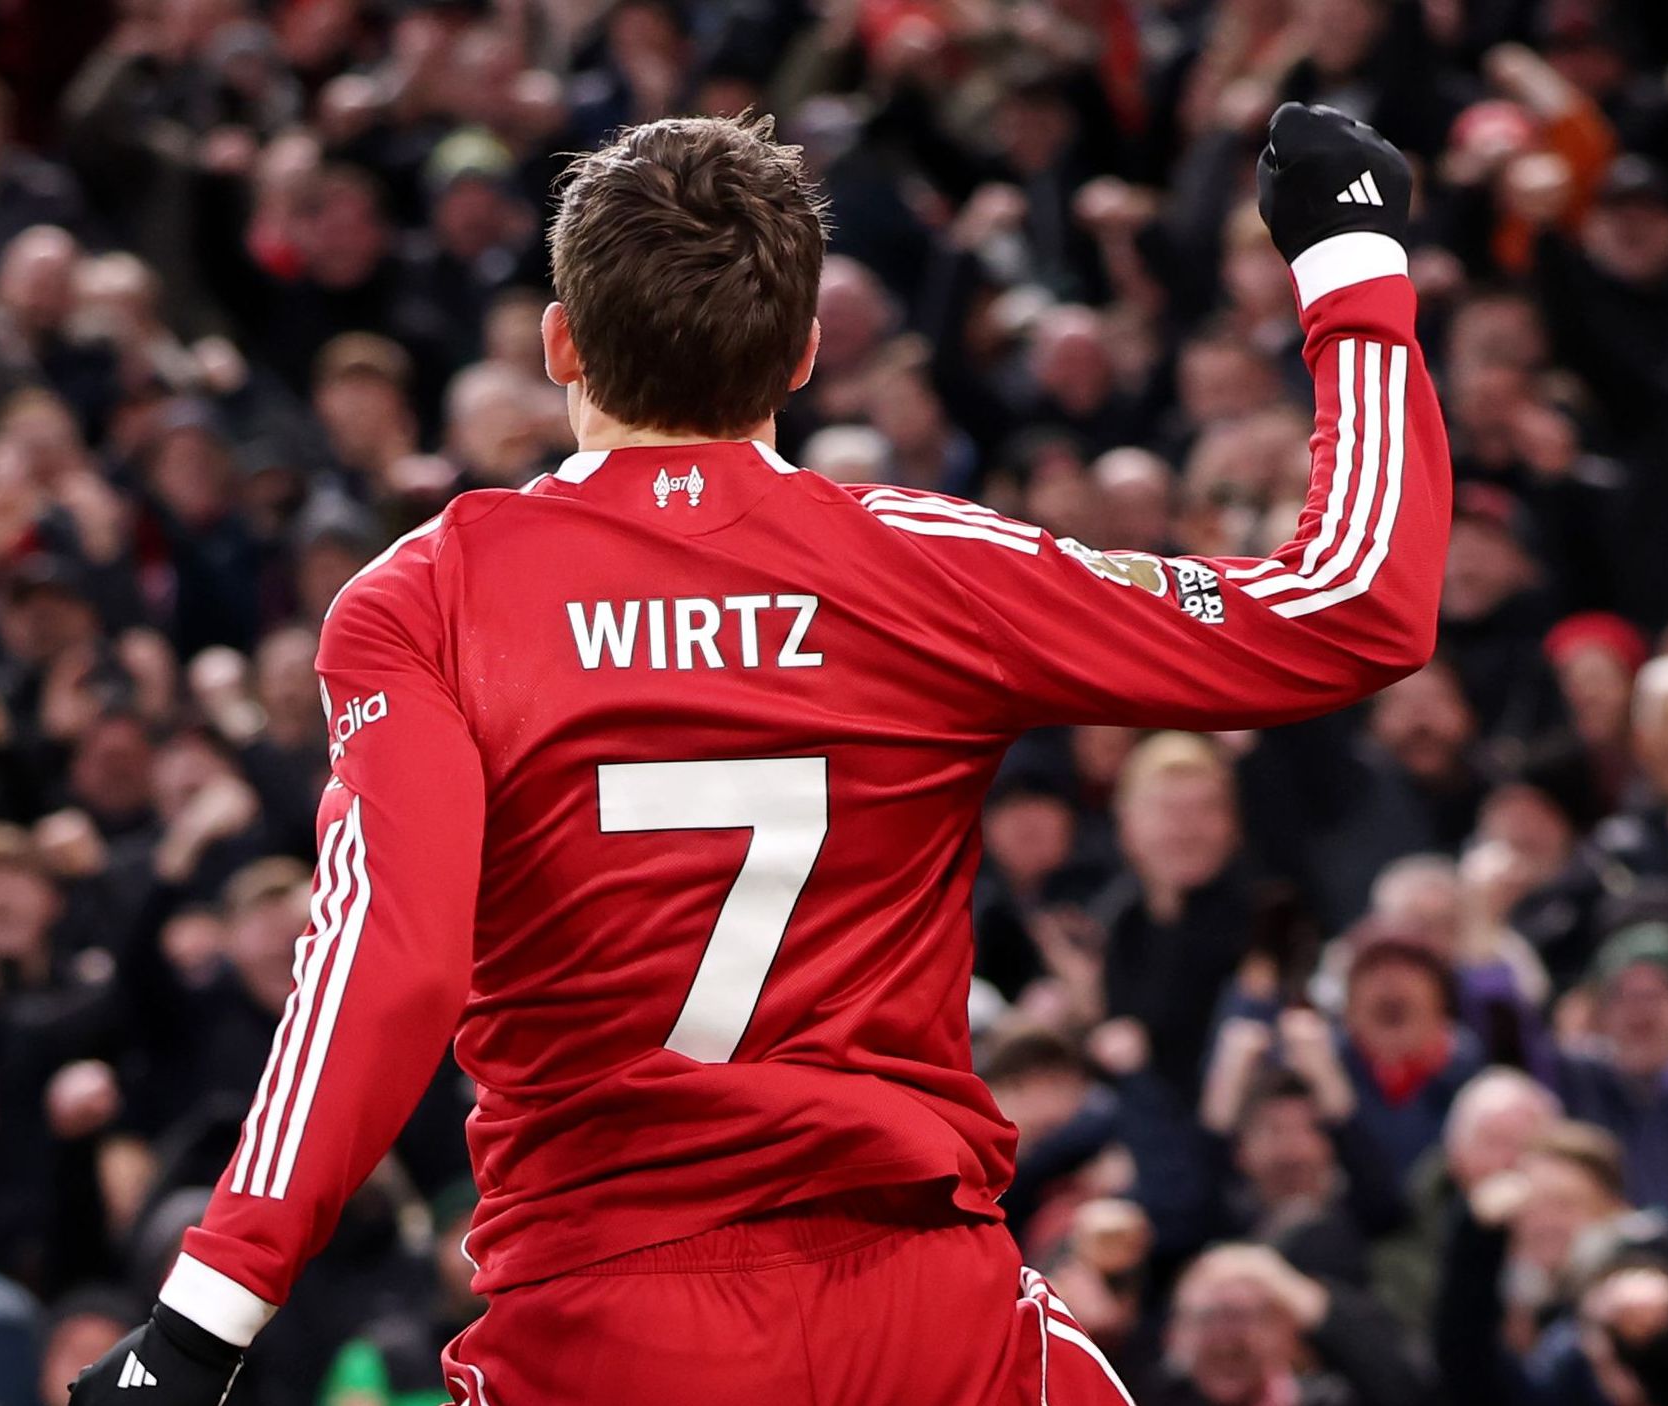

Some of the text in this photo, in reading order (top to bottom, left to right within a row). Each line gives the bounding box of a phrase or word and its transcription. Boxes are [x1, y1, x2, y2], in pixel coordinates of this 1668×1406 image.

[669, 475, 690, 492] 97
[565, 594, 824, 670] WIRTZ
[334, 691, 388, 747] dia
[597, 757, 828, 1064] 7
